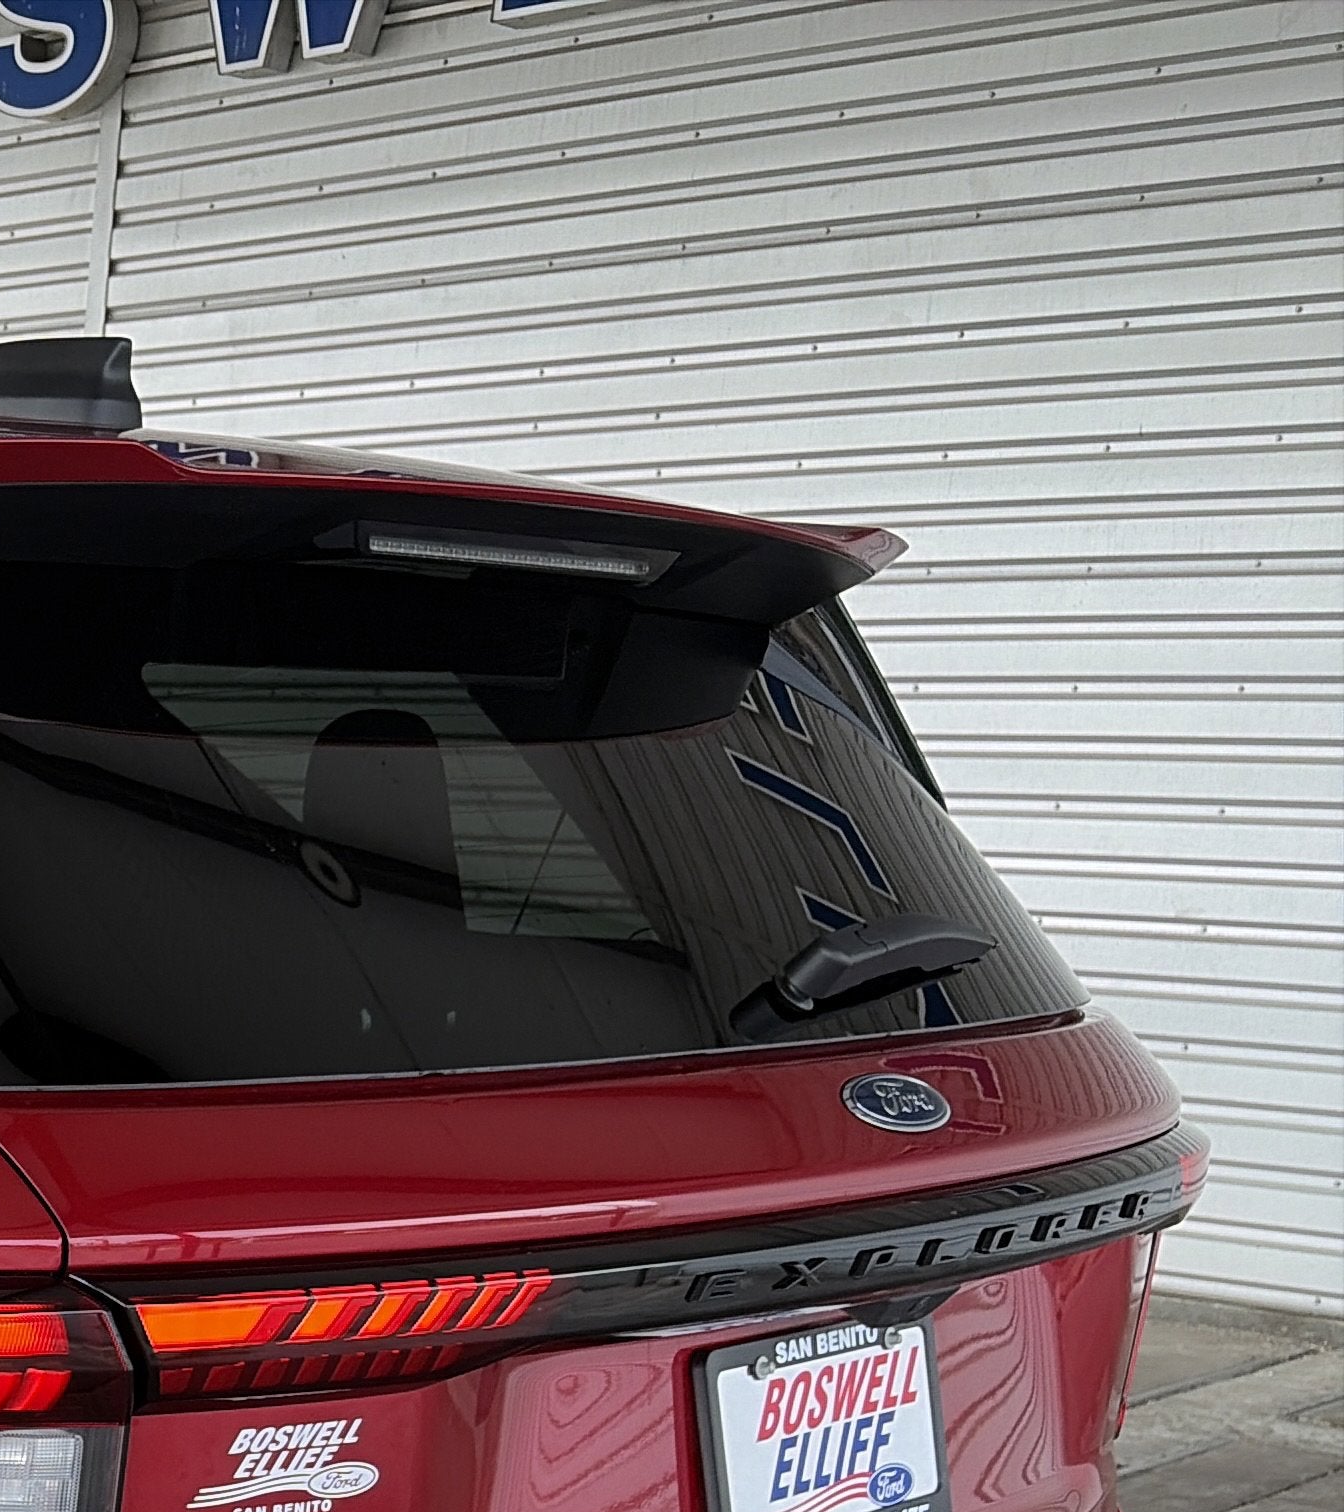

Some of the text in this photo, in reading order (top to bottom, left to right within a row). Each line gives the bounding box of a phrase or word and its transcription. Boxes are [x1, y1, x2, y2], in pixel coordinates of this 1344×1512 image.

[873, 1081, 935, 1116] Ford
[684, 1191, 1153, 1303] EXPLORER
[775, 1324, 879, 1363] SAN BENITO
[756, 1345, 920, 1443] BOSWELL
[227, 1417, 363, 1455] BOSWELL
[233, 1445, 340, 1479] ELLIFF
[769, 1411, 896, 1503] ELLIFF
[321, 1470, 362, 1490] Ford
[876, 1473, 906, 1500] Ford
